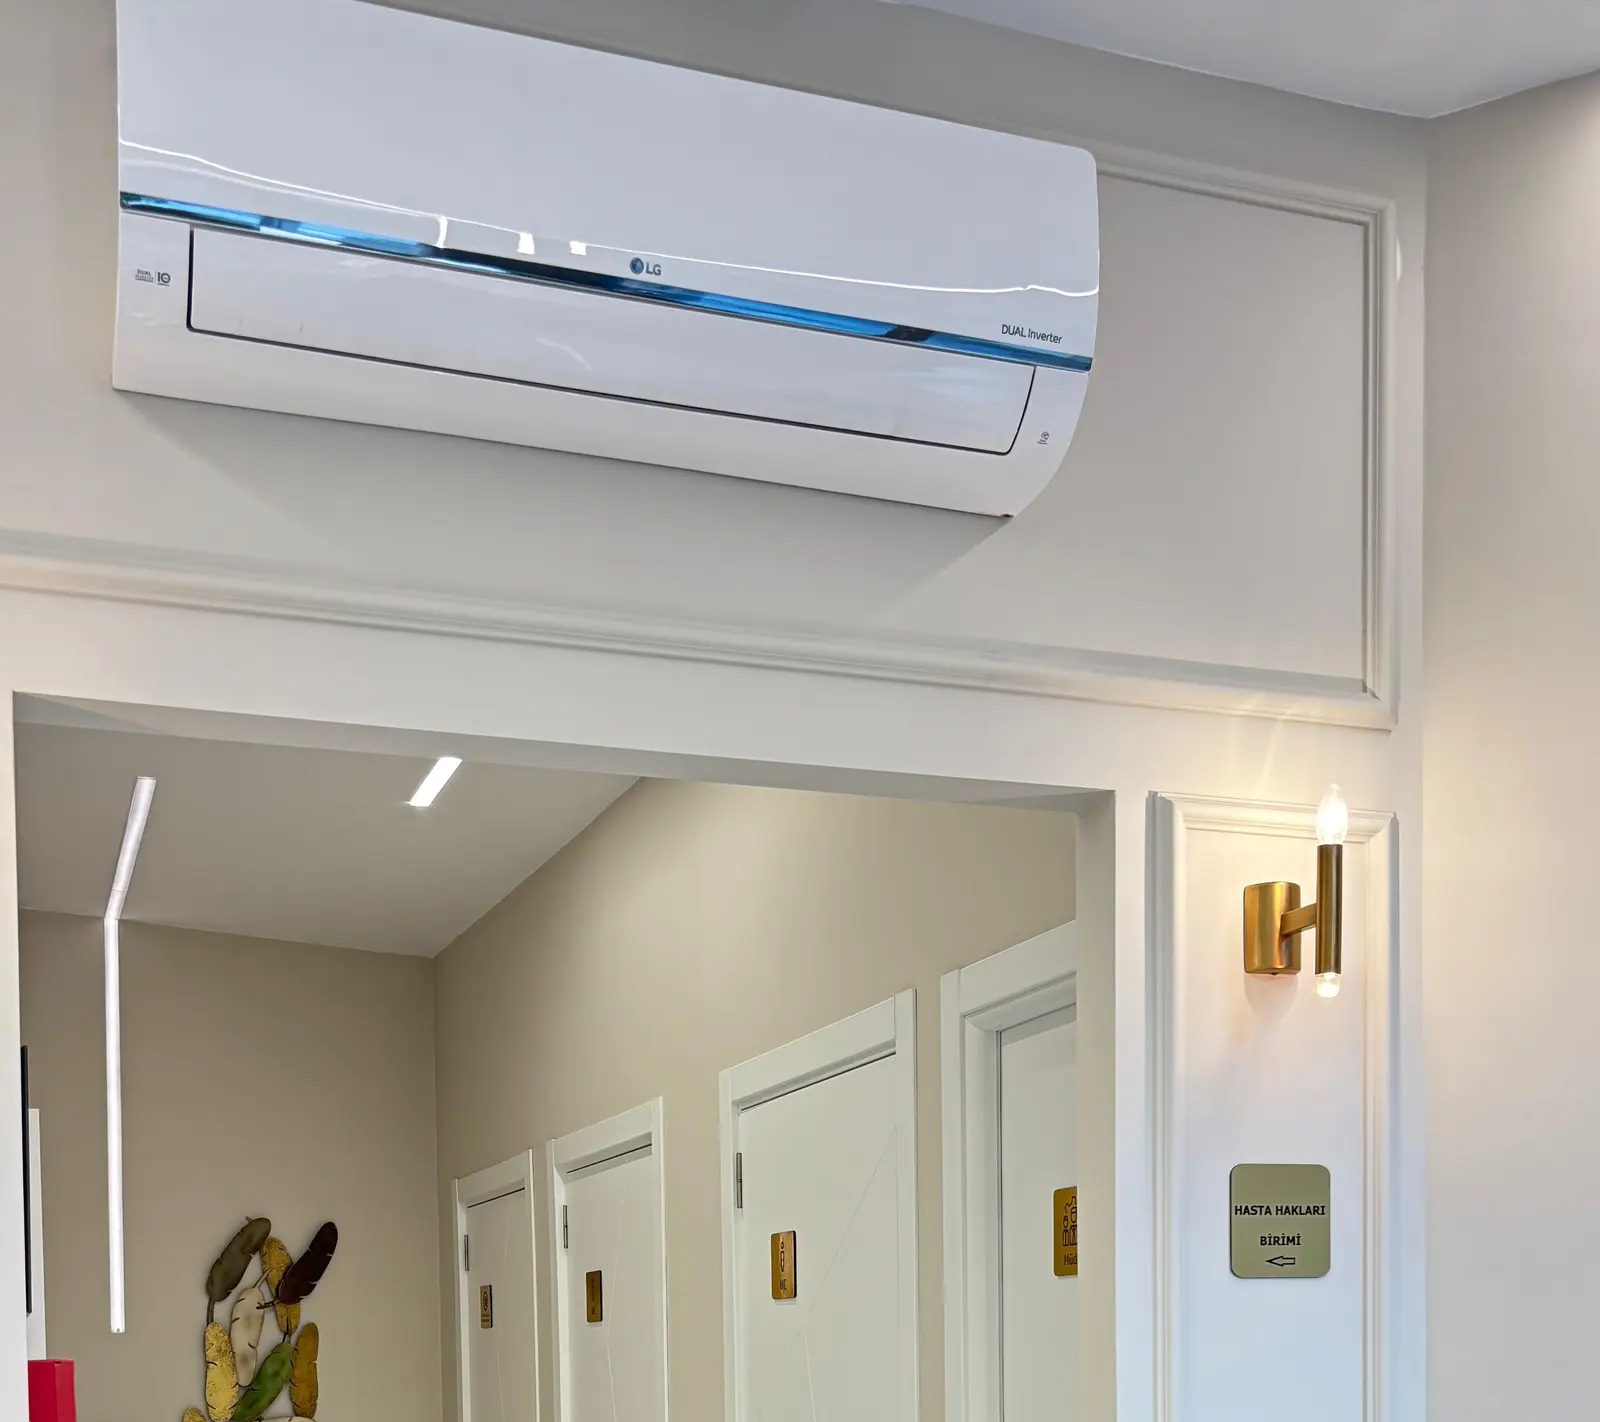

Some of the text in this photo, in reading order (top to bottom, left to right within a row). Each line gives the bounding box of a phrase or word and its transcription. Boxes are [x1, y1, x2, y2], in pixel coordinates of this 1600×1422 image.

[645, 261, 662, 276] LG
[1001, 324, 1063, 344] DUAL Inverter
[1234, 1205, 1326, 1216] HASTA HAKLARI
[1259, 1232, 1302, 1246] BİRİMİ
